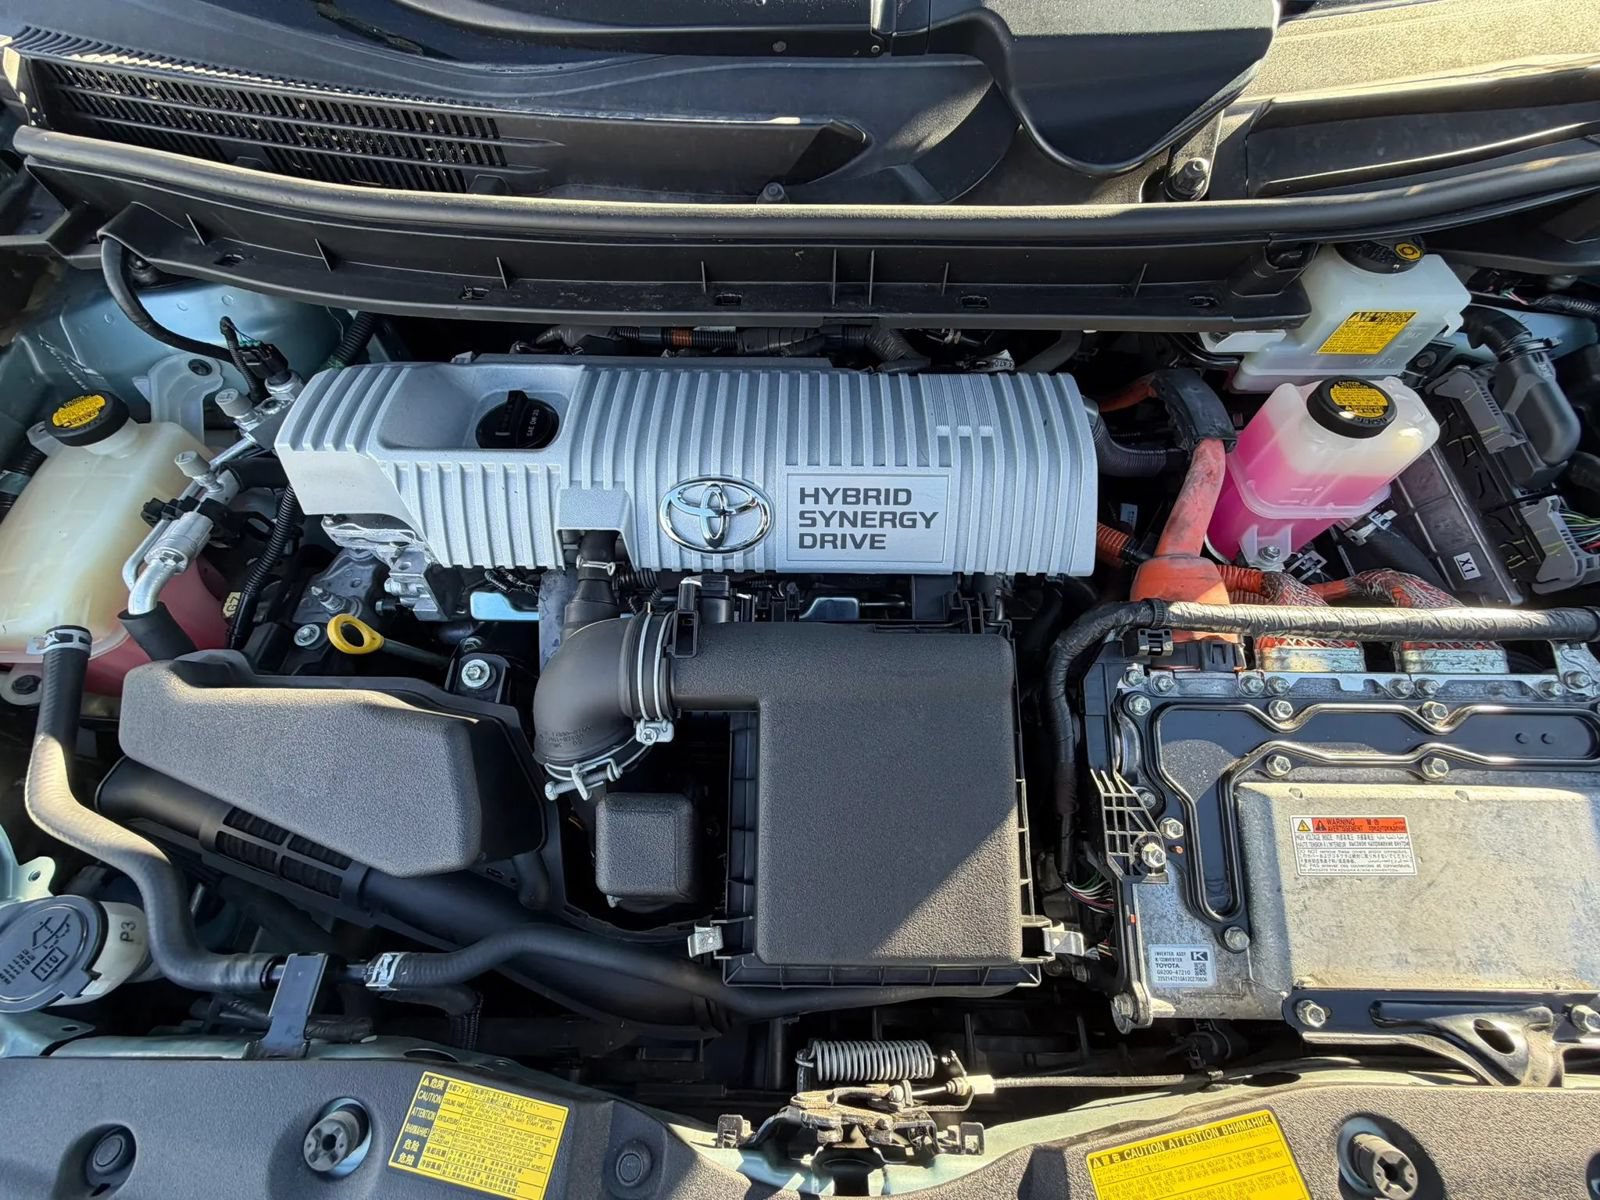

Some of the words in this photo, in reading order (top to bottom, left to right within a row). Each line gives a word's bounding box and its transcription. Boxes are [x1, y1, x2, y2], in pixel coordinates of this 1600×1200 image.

[799, 487, 912, 506] HYBRID
[798, 510, 939, 529] SYNERGY
[798, 533, 887, 550] DRIVE
[1459, 558, 1475, 573] X1
[120, 921, 137, 943] P3
[416, 1089, 442, 1104] CAUTION
[410, 1106, 436, 1121] ATTENTION
[1124, 1142, 1165, 1159] CAUTION
[1168, 1129, 1220, 1149] ATTENTION
[1222, 1115, 1272, 1136] ВНИМАНИЕ
